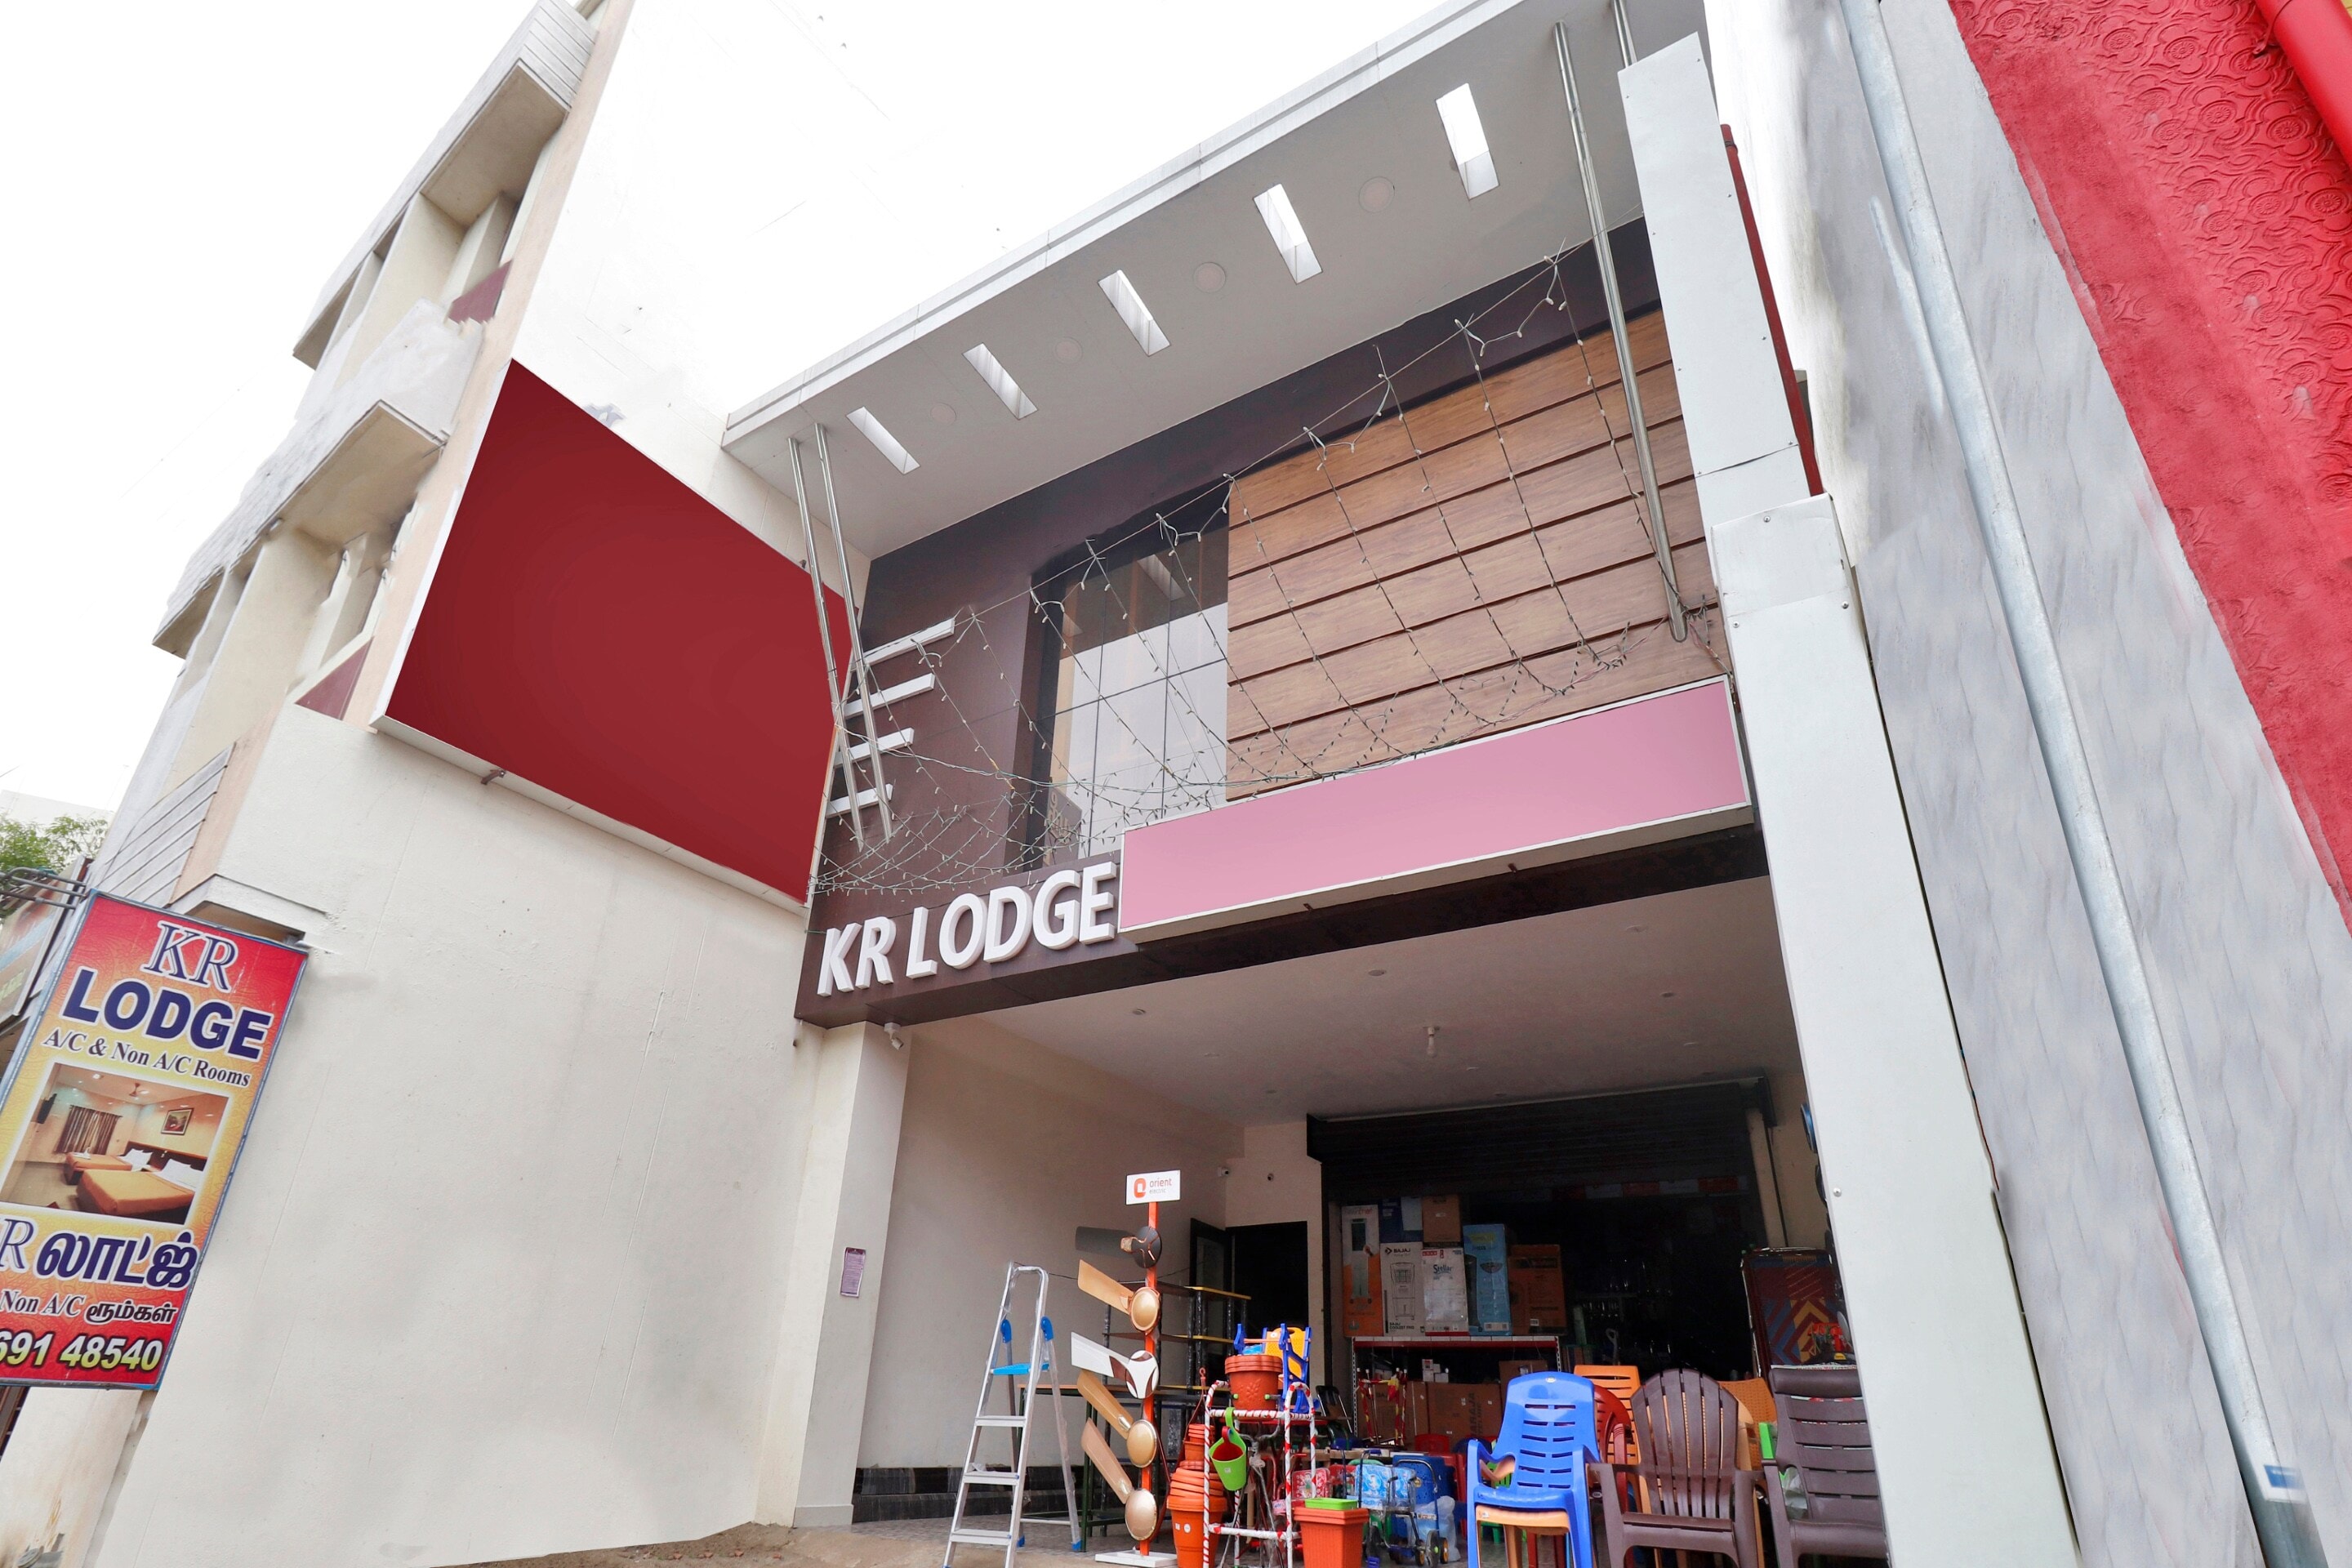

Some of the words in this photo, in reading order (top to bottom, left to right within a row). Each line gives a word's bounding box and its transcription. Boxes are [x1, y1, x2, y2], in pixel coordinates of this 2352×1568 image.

[143, 922, 238, 991] KR
[817, 915, 897, 997] KR
[906, 862, 1117, 979] LODGE
[62, 969, 272, 1060] LODGE
[43, 1028, 87, 1051] A/C
[88, 1038, 108, 1057] &
[111, 1042, 151, 1066] Non
[153, 1054, 192, 1074] A/C
[194, 1060, 251, 1087] Rooms
[1149, 1178, 1172, 1187] orient
[0, 1218, 34, 1269] R
[36, 1232, 198, 1288] லாட்ஜ்
[0, 1290, 39, 1314] Non
[41, 1294, 86, 1316] A/C
[86, 1300, 176, 1323] ரூம்கள்
[60, 1335, 163, 1371] 48540
